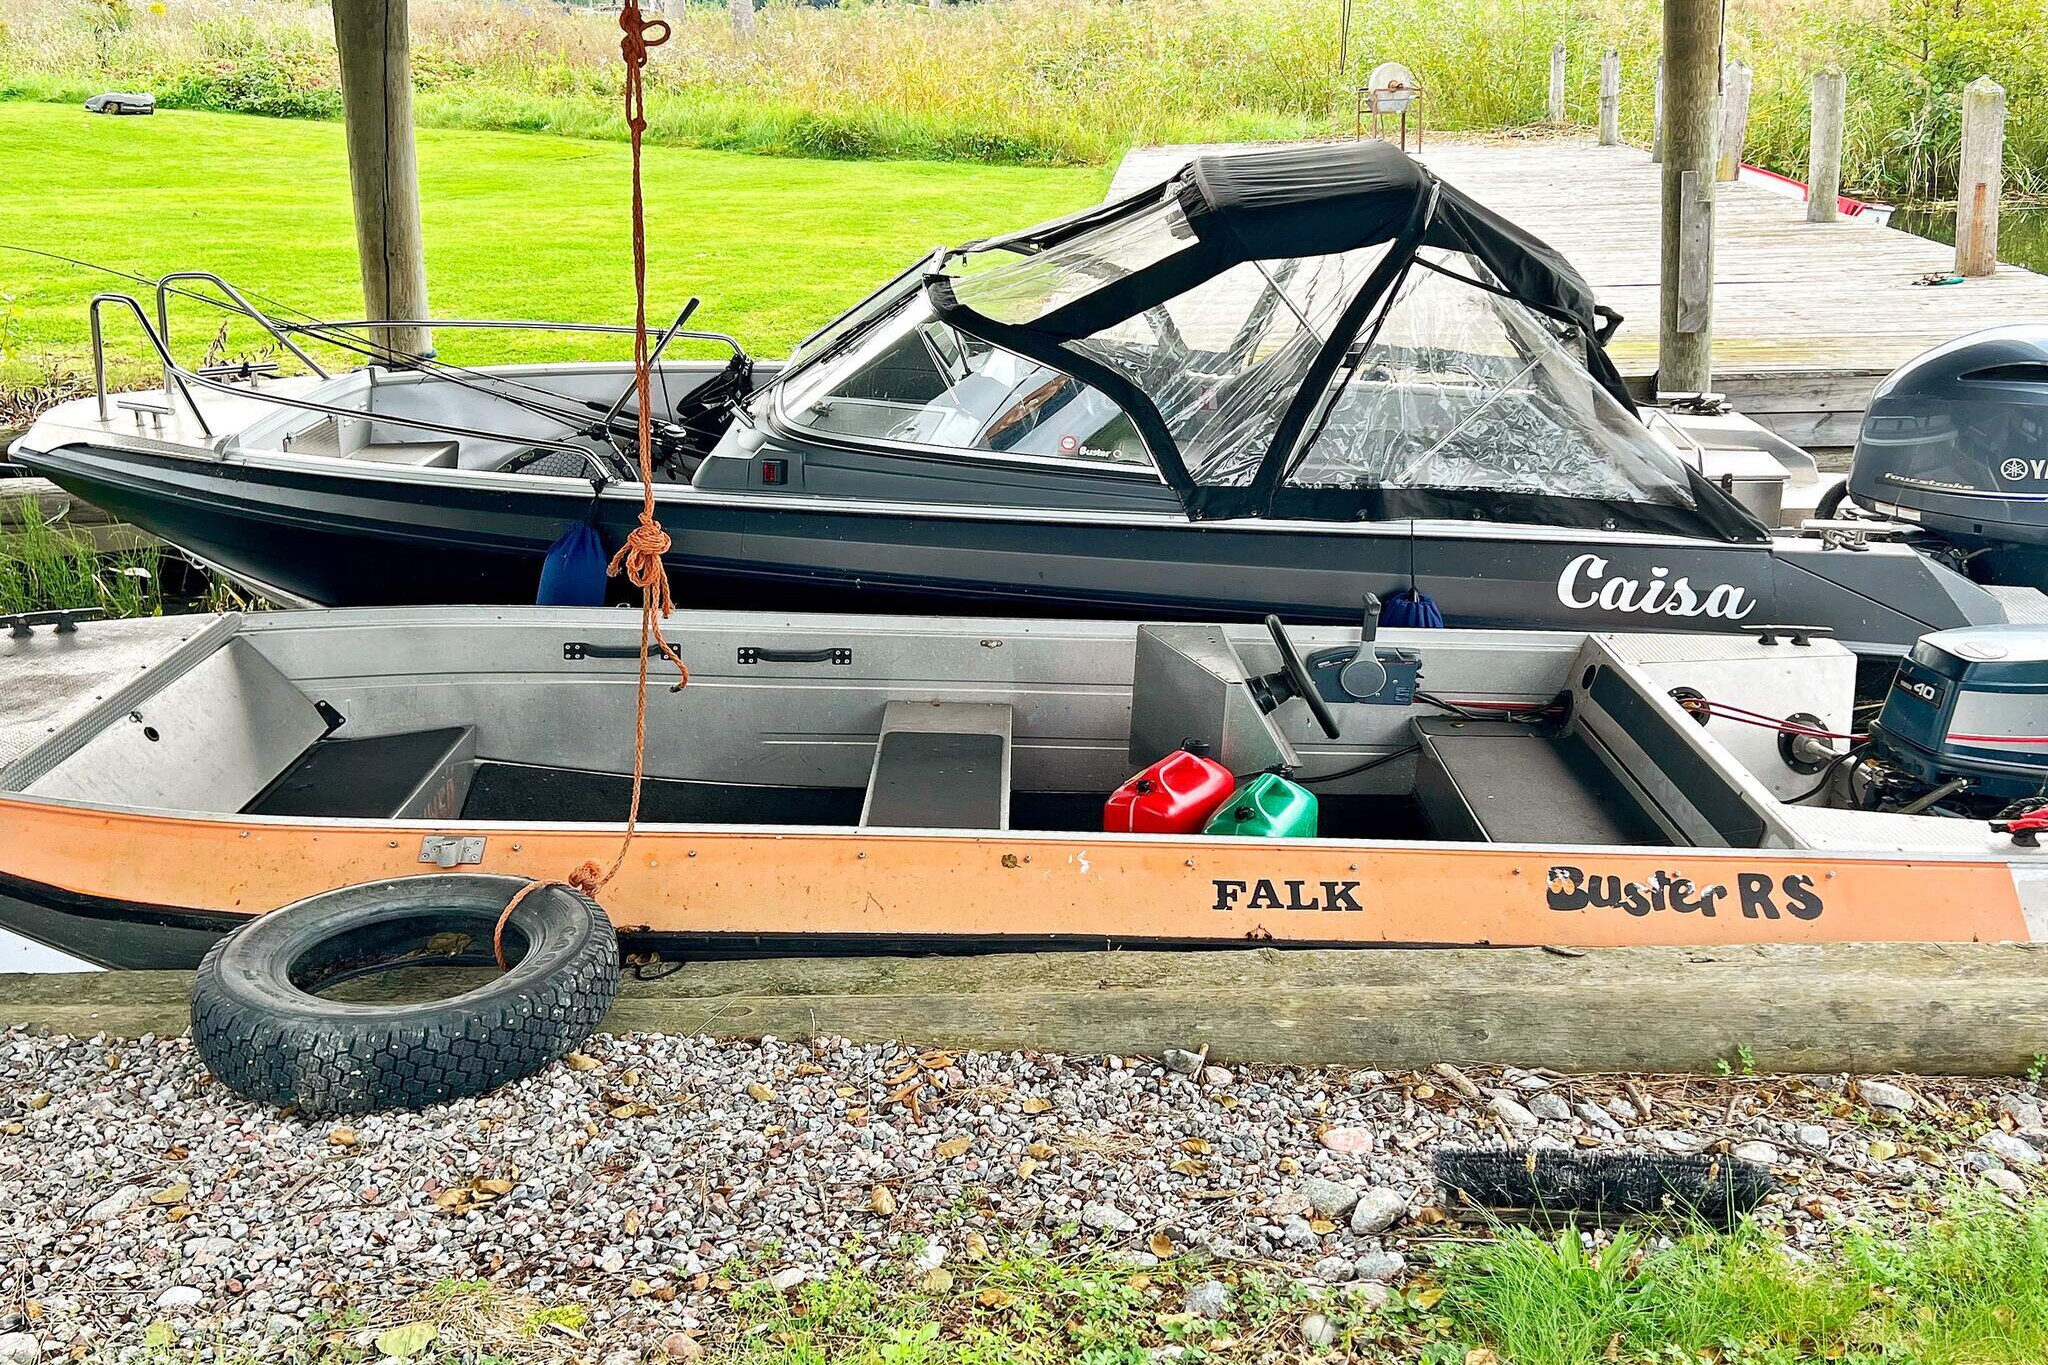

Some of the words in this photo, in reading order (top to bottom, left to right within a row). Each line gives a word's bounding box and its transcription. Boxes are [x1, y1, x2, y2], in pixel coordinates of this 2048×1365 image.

[1079, 445, 1112, 458] Buster
[2029, 459, 2048, 480] Y
[1556, 553, 1757, 620] Caisa
[1913, 682, 1936, 700] 40
[1211, 878, 1364, 912] FALK
[1546, 866, 1728, 917] Buster
